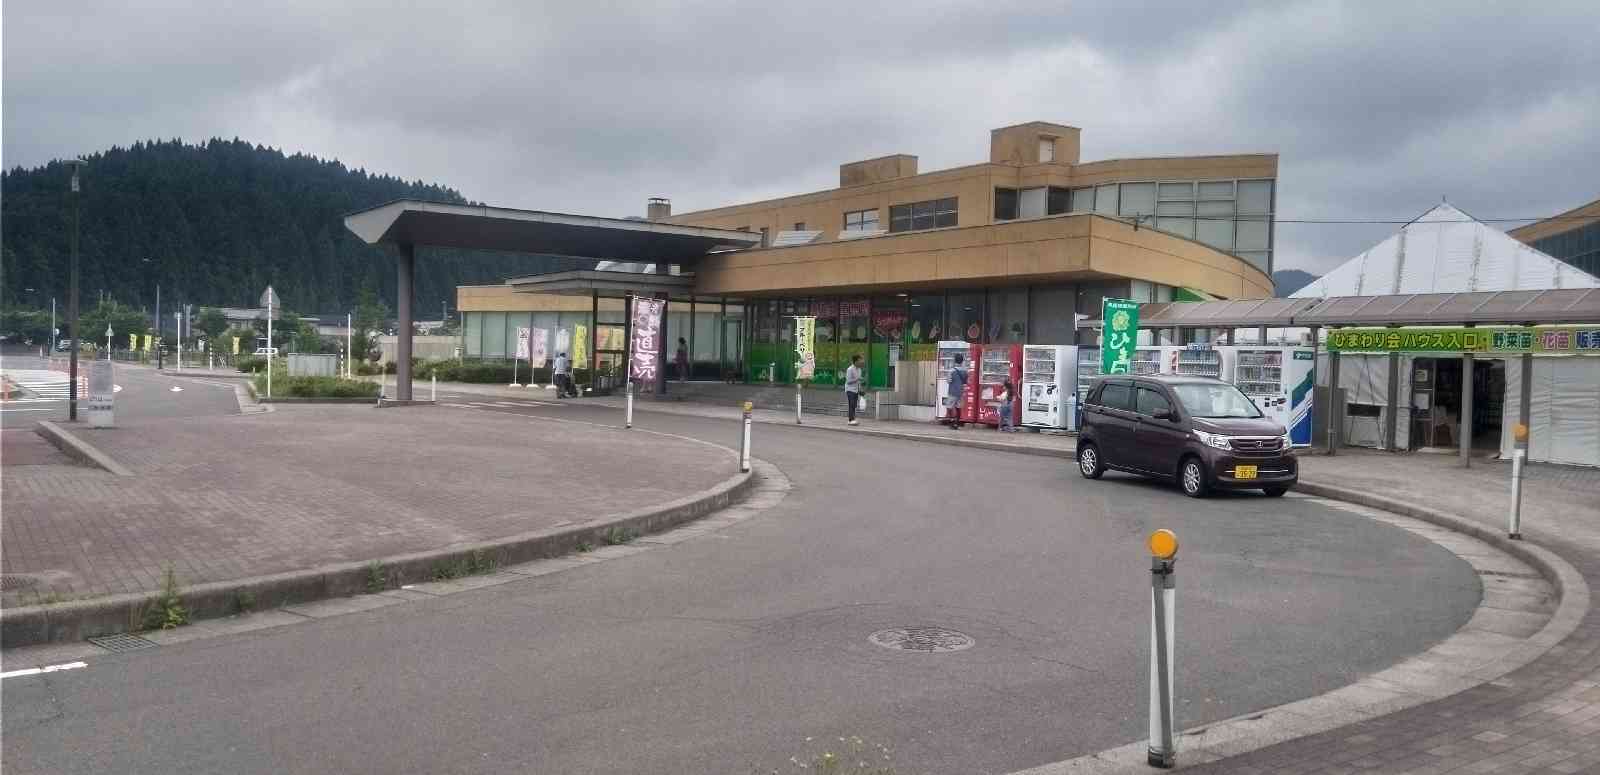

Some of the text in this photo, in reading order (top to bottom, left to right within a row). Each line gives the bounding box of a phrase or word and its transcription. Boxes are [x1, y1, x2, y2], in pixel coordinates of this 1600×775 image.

[634, 326, 659, 379] 直売
[1335, 332, 1400, 349] ひまわり会
